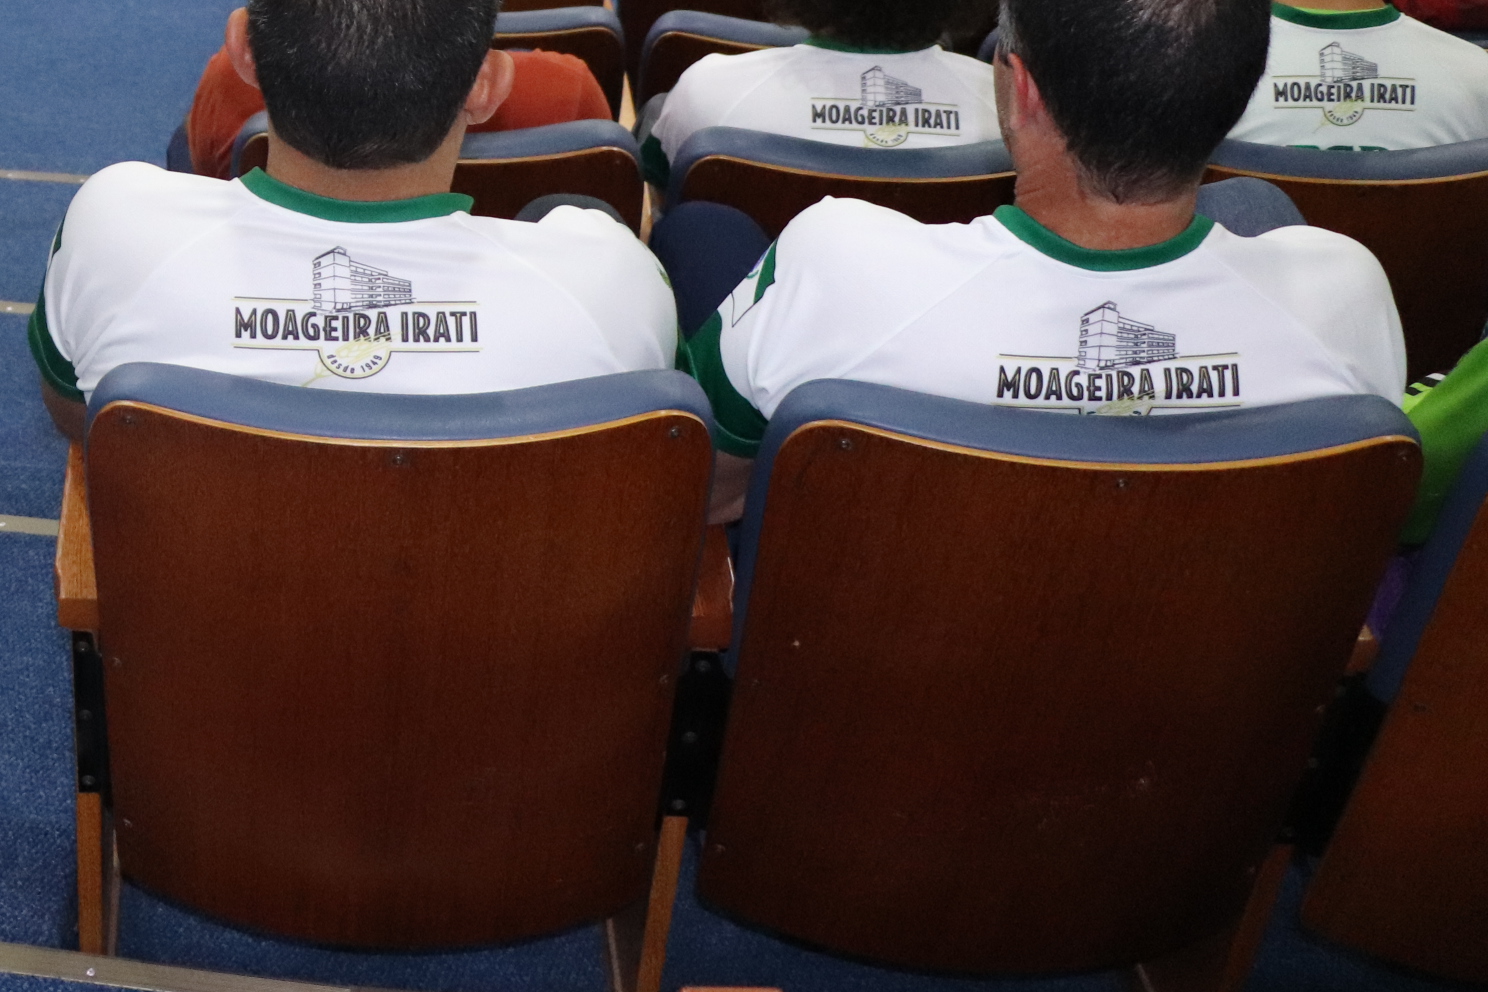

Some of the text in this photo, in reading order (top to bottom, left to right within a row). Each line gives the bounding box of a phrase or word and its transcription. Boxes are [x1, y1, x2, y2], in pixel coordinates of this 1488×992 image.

[1273, 81, 1416, 106] MOAGEIRA IRATI
[811, 103, 960, 131] MOAGEIRA IRATI
[234, 306, 478, 343] MOAGEIRA IRATI
[326, 353, 383, 375] desde 1949
[996, 362, 1241, 402] MOAGEIRA IRATI
